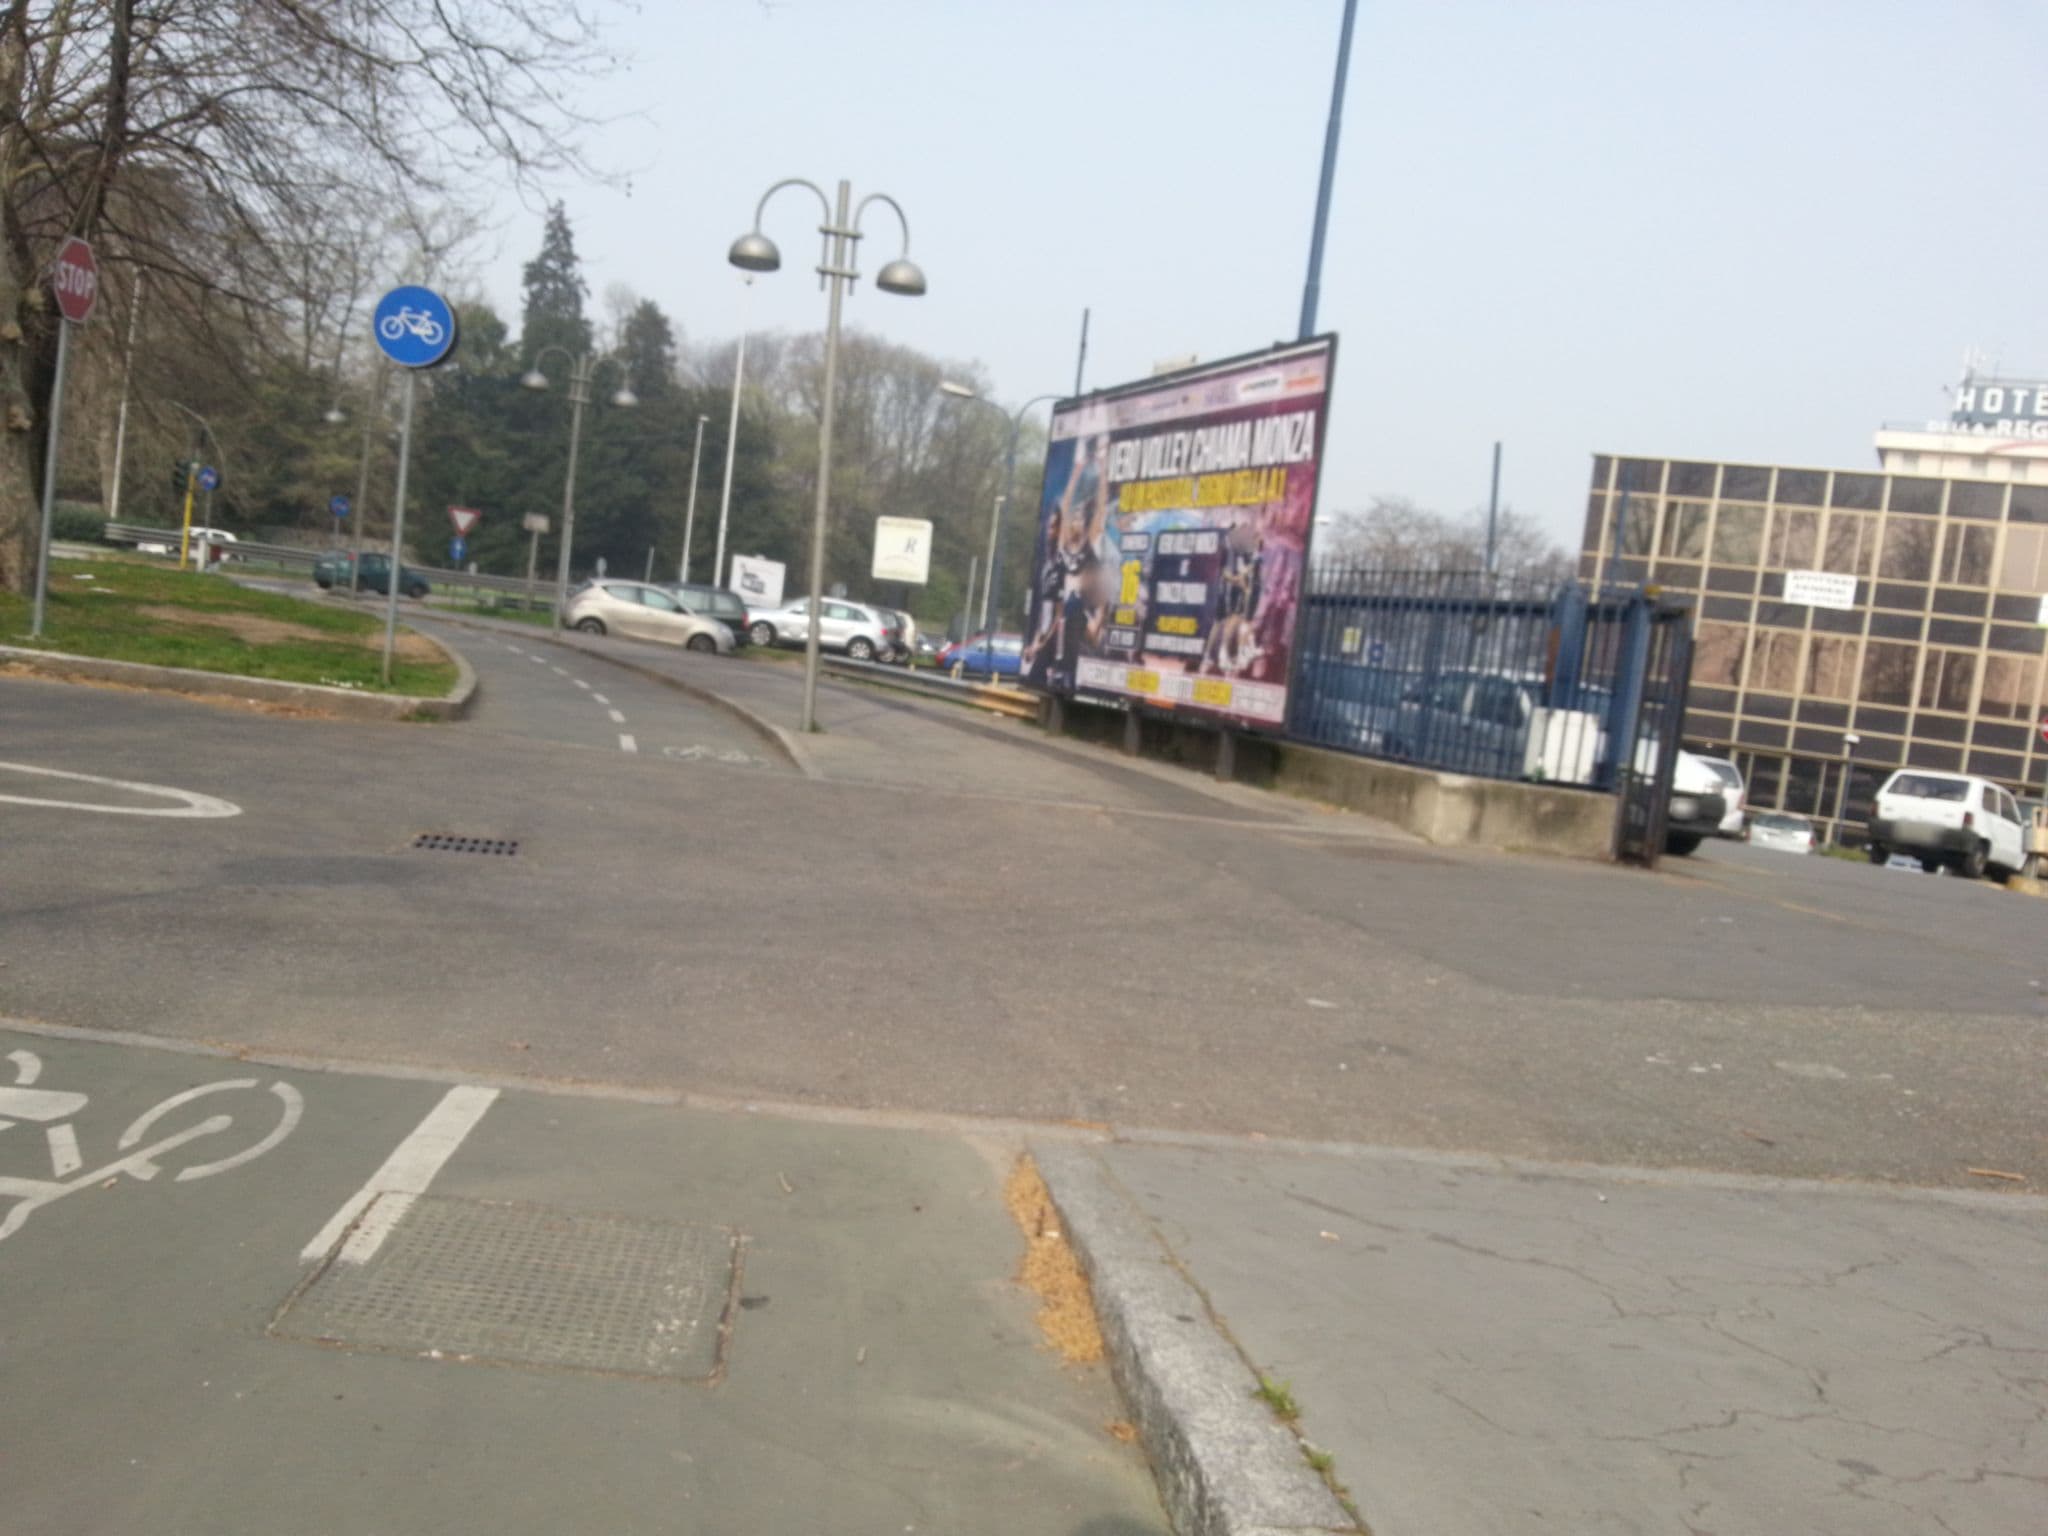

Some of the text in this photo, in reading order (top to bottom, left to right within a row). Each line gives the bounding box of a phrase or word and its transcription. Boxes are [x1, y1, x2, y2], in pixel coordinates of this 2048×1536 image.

[57, 261, 94, 298] STOP
[1108, 440, 1141, 482] VERO
[1141, 432, 1193, 479] VOLLEY
[1251, 410, 1316, 467] MONZA
